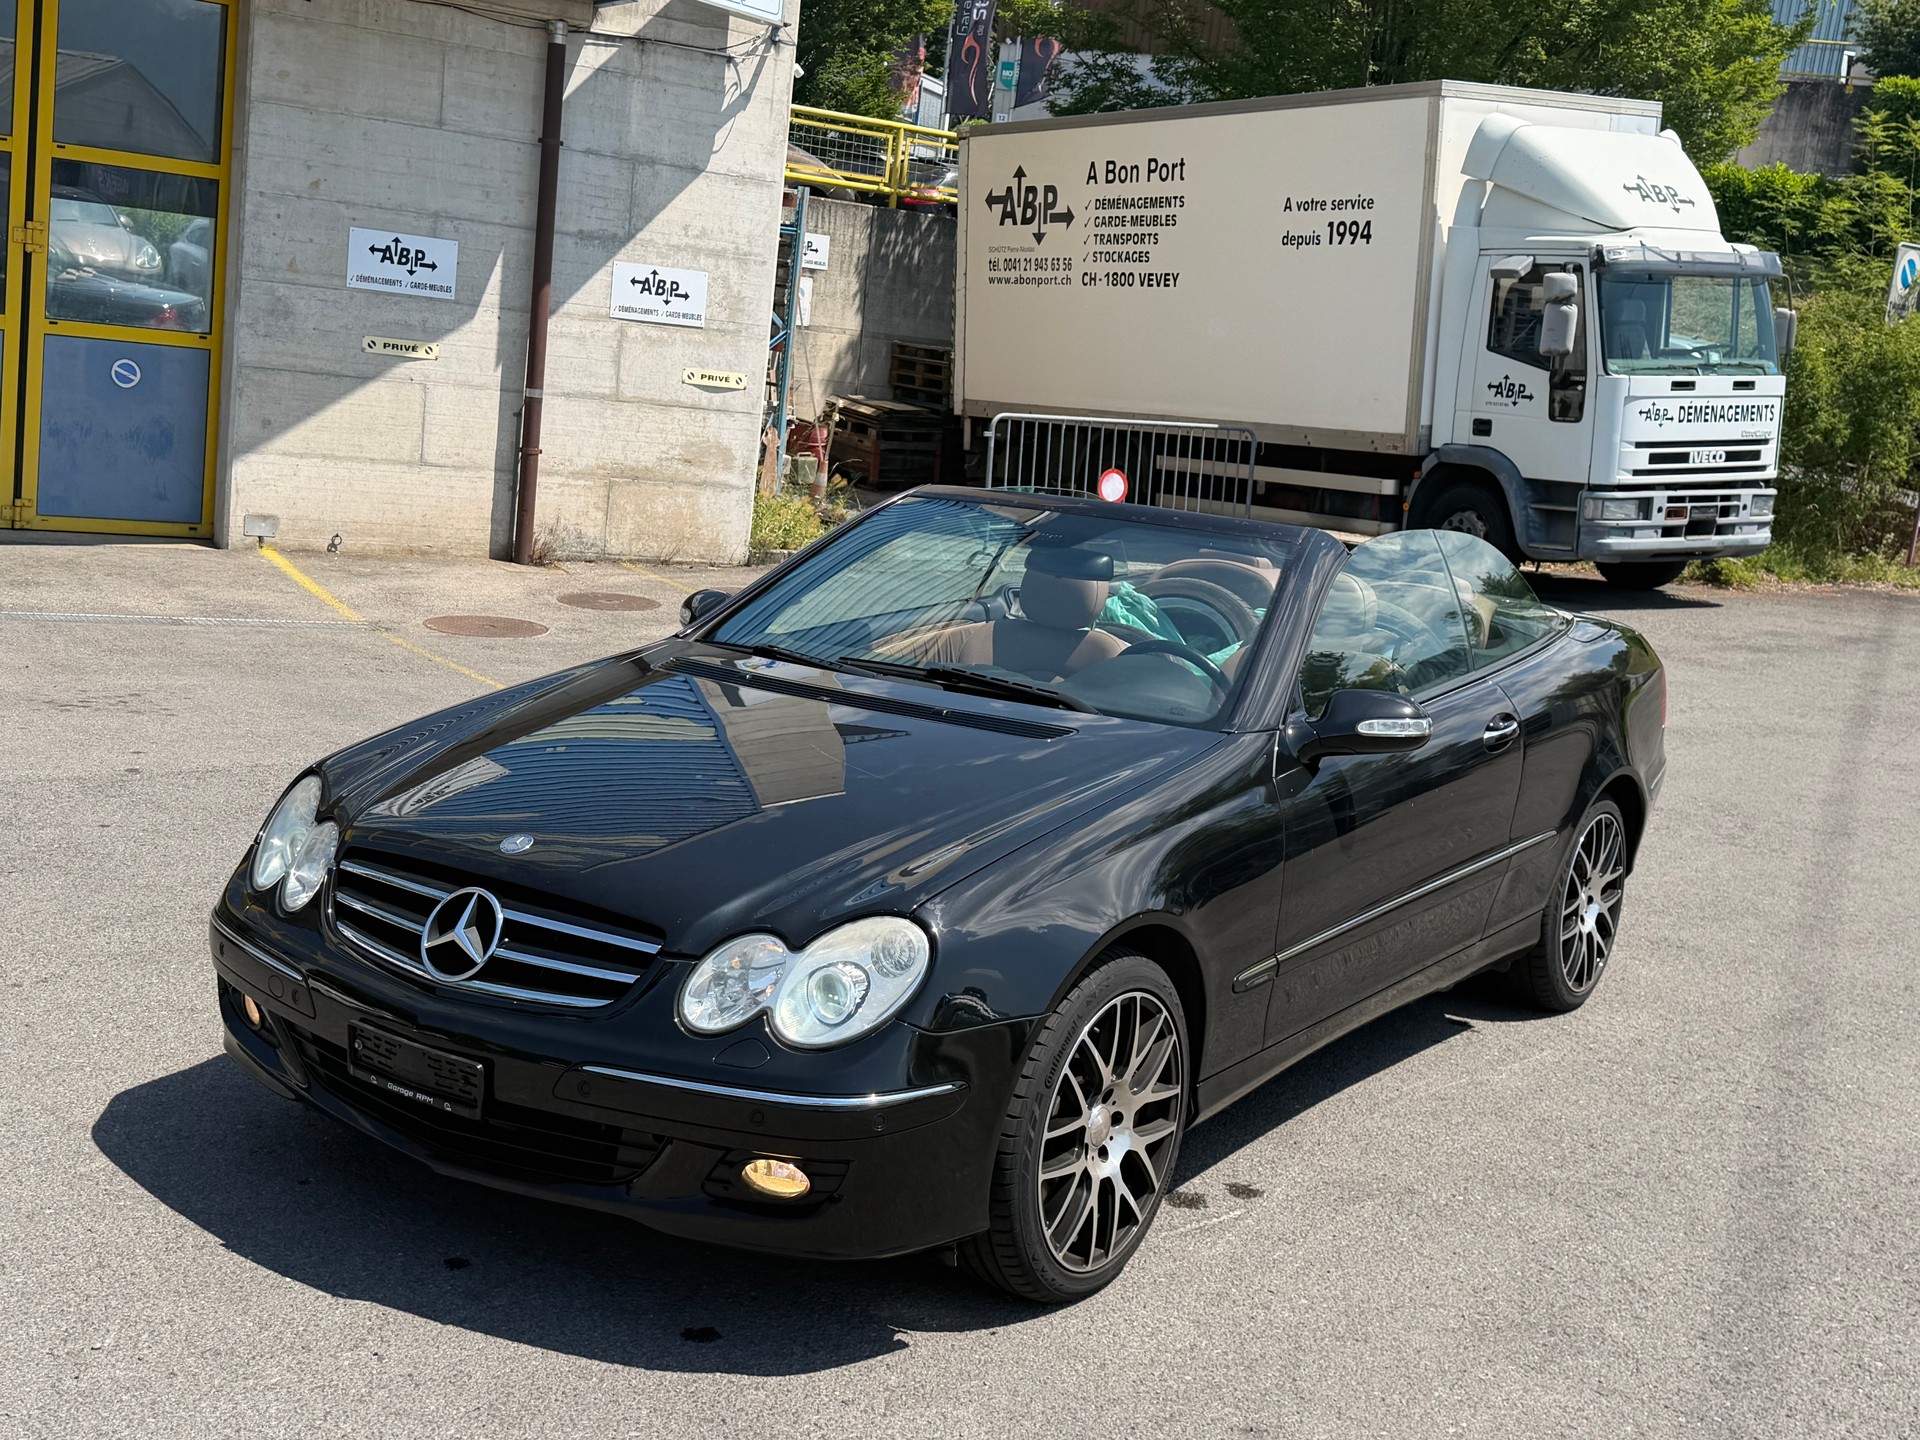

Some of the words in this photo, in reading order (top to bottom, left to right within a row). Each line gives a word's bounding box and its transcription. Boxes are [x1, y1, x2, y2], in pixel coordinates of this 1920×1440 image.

[1086, 161, 1098, 185] A
[1105, 160, 1140, 184] Bon
[1147, 157, 1186, 182] Port
[999, 184, 1058, 226] ABP
[1094, 195, 1185, 210] DÉMÉNAGEMENTS
[1283, 197, 1293, 212] A
[1296, 198, 1328, 212] votre
[1330, 194, 1375, 211] service
[1094, 214, 1177, 228] GARDE-MEUBLES
[1093, 232, 1159, 246] TRANSPORTS
[1282, 230, 1321, 250] depuis
[1327, 220, 1372, 245] 1994
[380, 244, 426, 268] ABP
[988, 257, 1001, 272] tél.
[1003, 258, 1021, 272] 0041
[1024, 258, 1032, 271] 21
[1034, 257, 1048, 271] 943
[1051, 257, 1060, 271] 63
[1062, 257, 1072, 271] 56
[1092, 250, 1150, 264] STOCKAGES
[356, 274, 402, 288] DÉMÉNAGEMENTS
[410, 281, 452, 294] GARDE-MEUBLES
[640, 276, 680, 298] ABP
[988, 274, 1072, 288] www.abonport.ch
[1138, 272, 1180, 288] VEVEY
[383, 342, 419, 352] PRIVÉ
[700, 373, 730, 383] PRIVÉ
[1494, 382, 1526, 399] ABP
[1645, 407, 1669, 421] ABP
[1678, 400, 1774, 423] DÉMÉNAGEMENTS
[1688, 450, 1726, 464] IVECO
[1044, 1020, 1079, 1090] Continental
[387, 1082, 414, 1097] Garage
[416, 1092, 434, 1104] RPM
